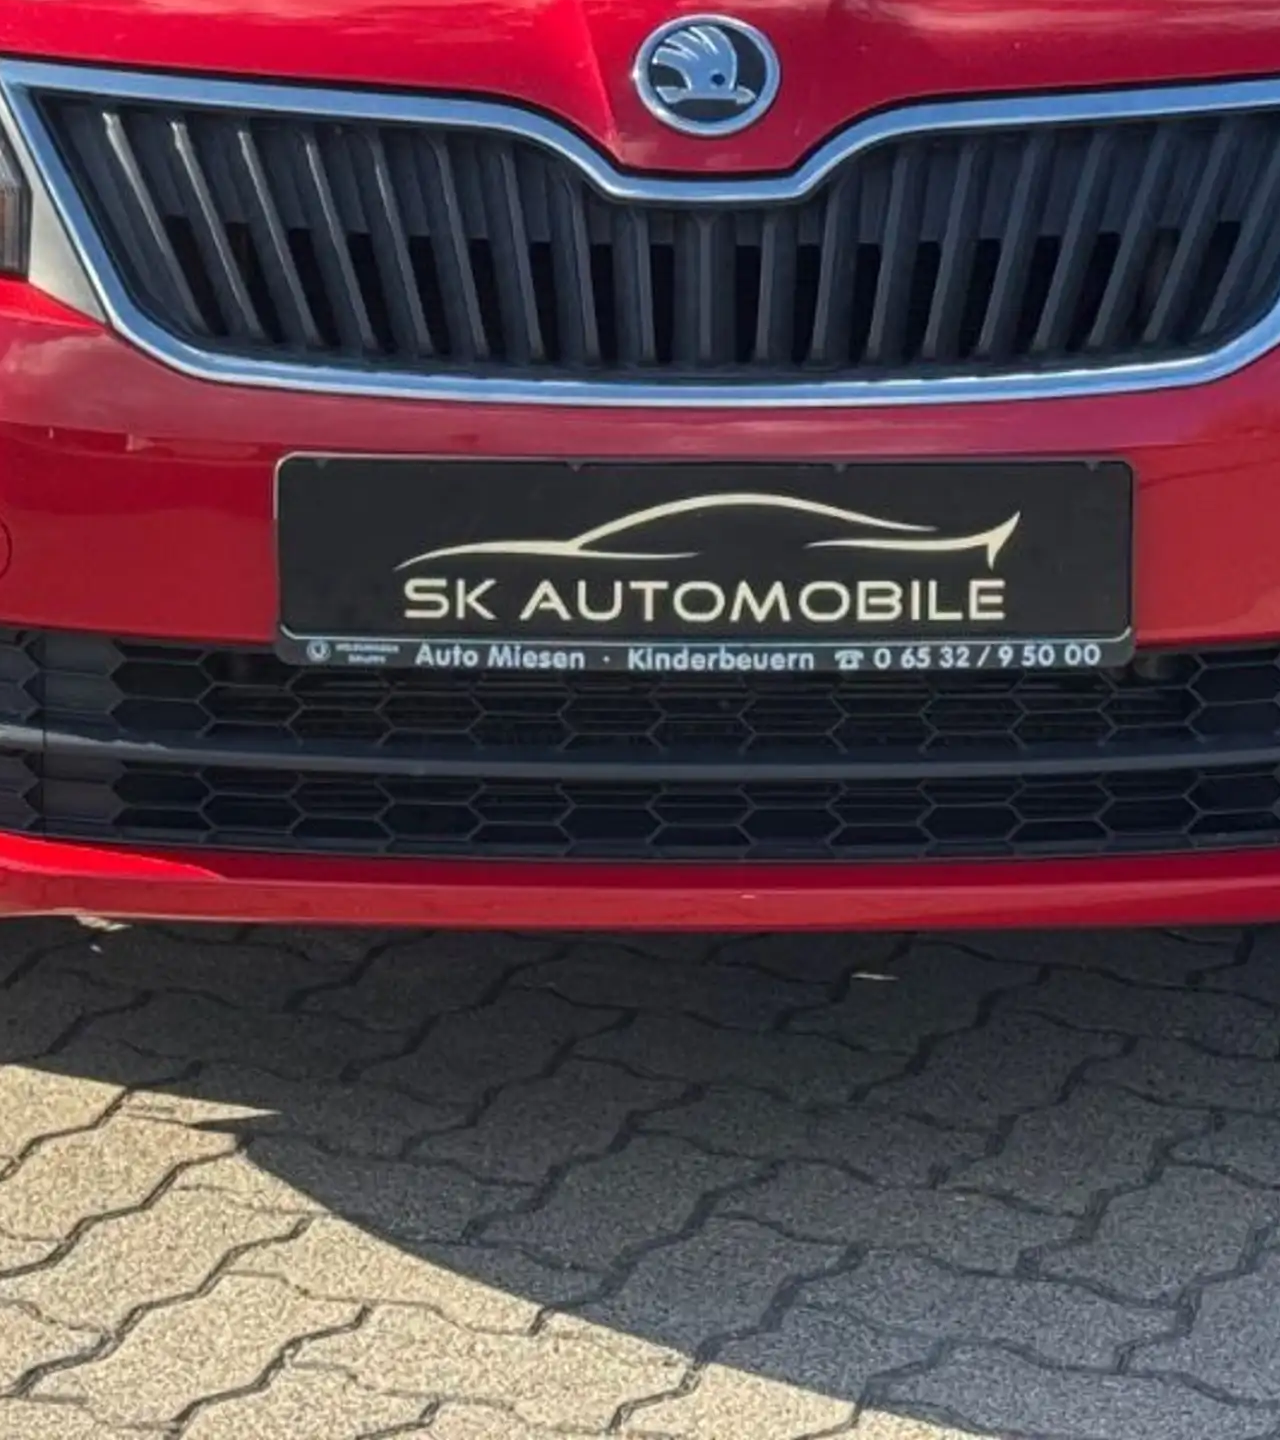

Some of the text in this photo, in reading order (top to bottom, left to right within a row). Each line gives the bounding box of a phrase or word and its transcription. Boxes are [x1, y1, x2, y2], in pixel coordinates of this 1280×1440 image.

[403, 578, 1006, 622] SK AUTOMOBILE
[414, 644, 478, 667] Auto
[487, 645, 586, 670] Miesen
[627, 647, 815, 671] Kinderbeuern
[873, 647, 892, 669] 0
[900, 647, 932, 669] 65
[939, 646, 970, 668] 32
[998, 645, 1014, 667] 9
[1021, 644, 1056, 666] 50
[1064, 643, 1102, 666] 00
